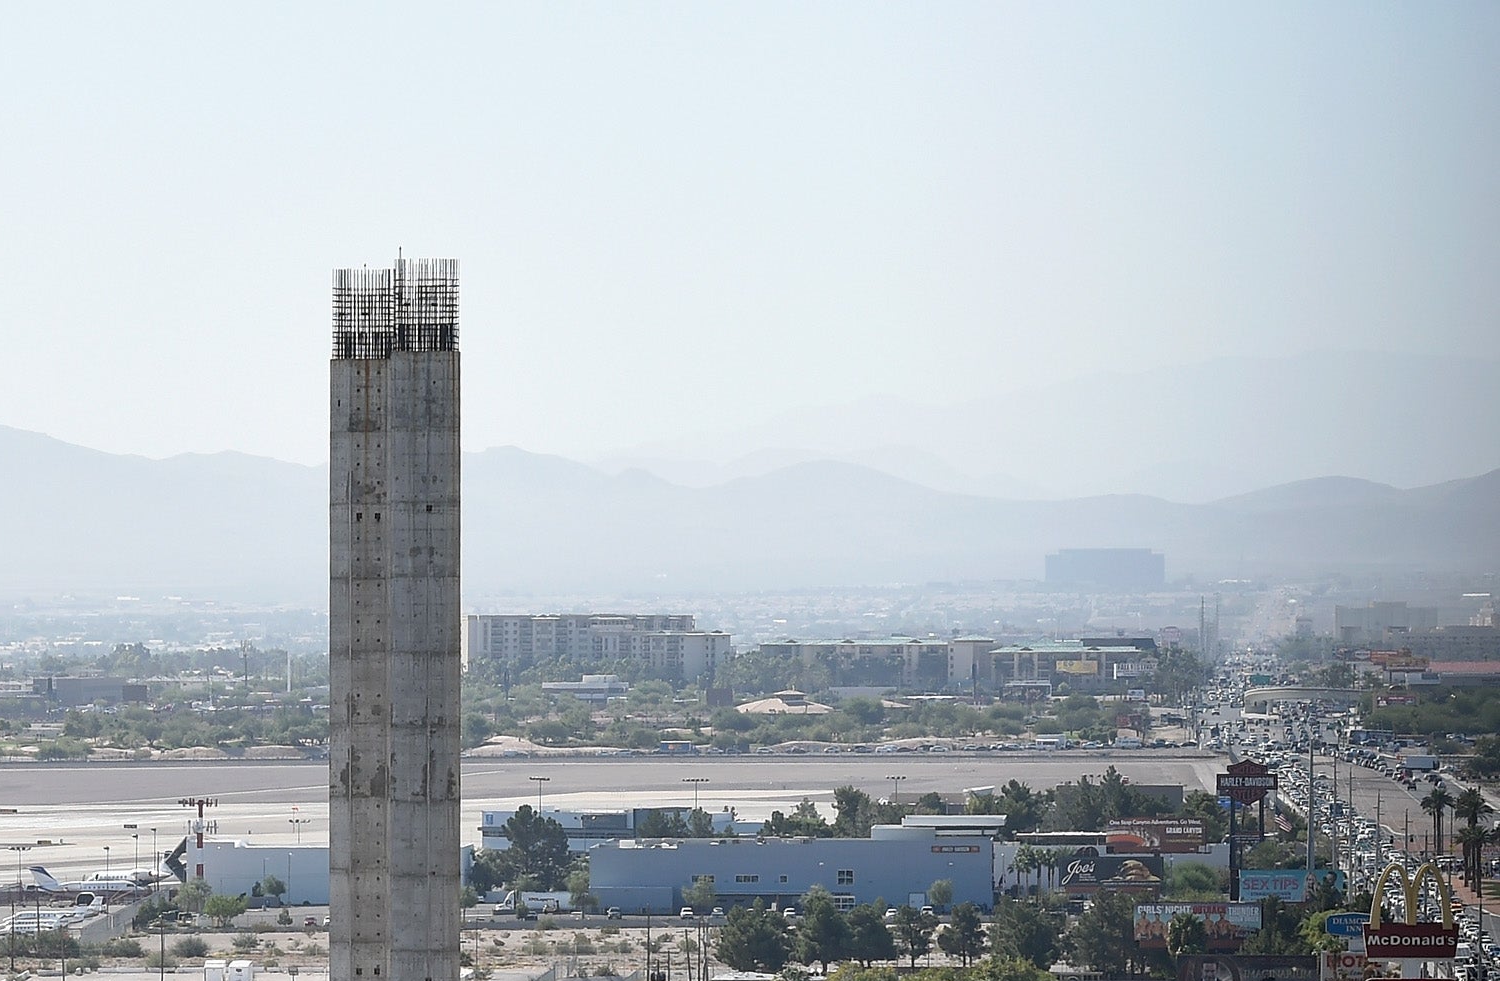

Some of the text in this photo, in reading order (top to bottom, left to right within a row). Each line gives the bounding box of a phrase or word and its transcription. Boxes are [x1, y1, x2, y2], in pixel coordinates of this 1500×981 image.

[1220, 777, 1275, 787] HARLEY-DAVIDSON
[1062, 859, 1096, 885] Joe's
[1243, 878, 1299, 890] SEX TIPS
[1137, 905, 1164, 914] GIRLS'
[1165, 905, 1191, 914] NIGHT
[1228, 906, 1260, 914] THUNDER
[1332, 917, 1368, 925] DIAMO
[1367, 935, 1456, 946] McDonald's
